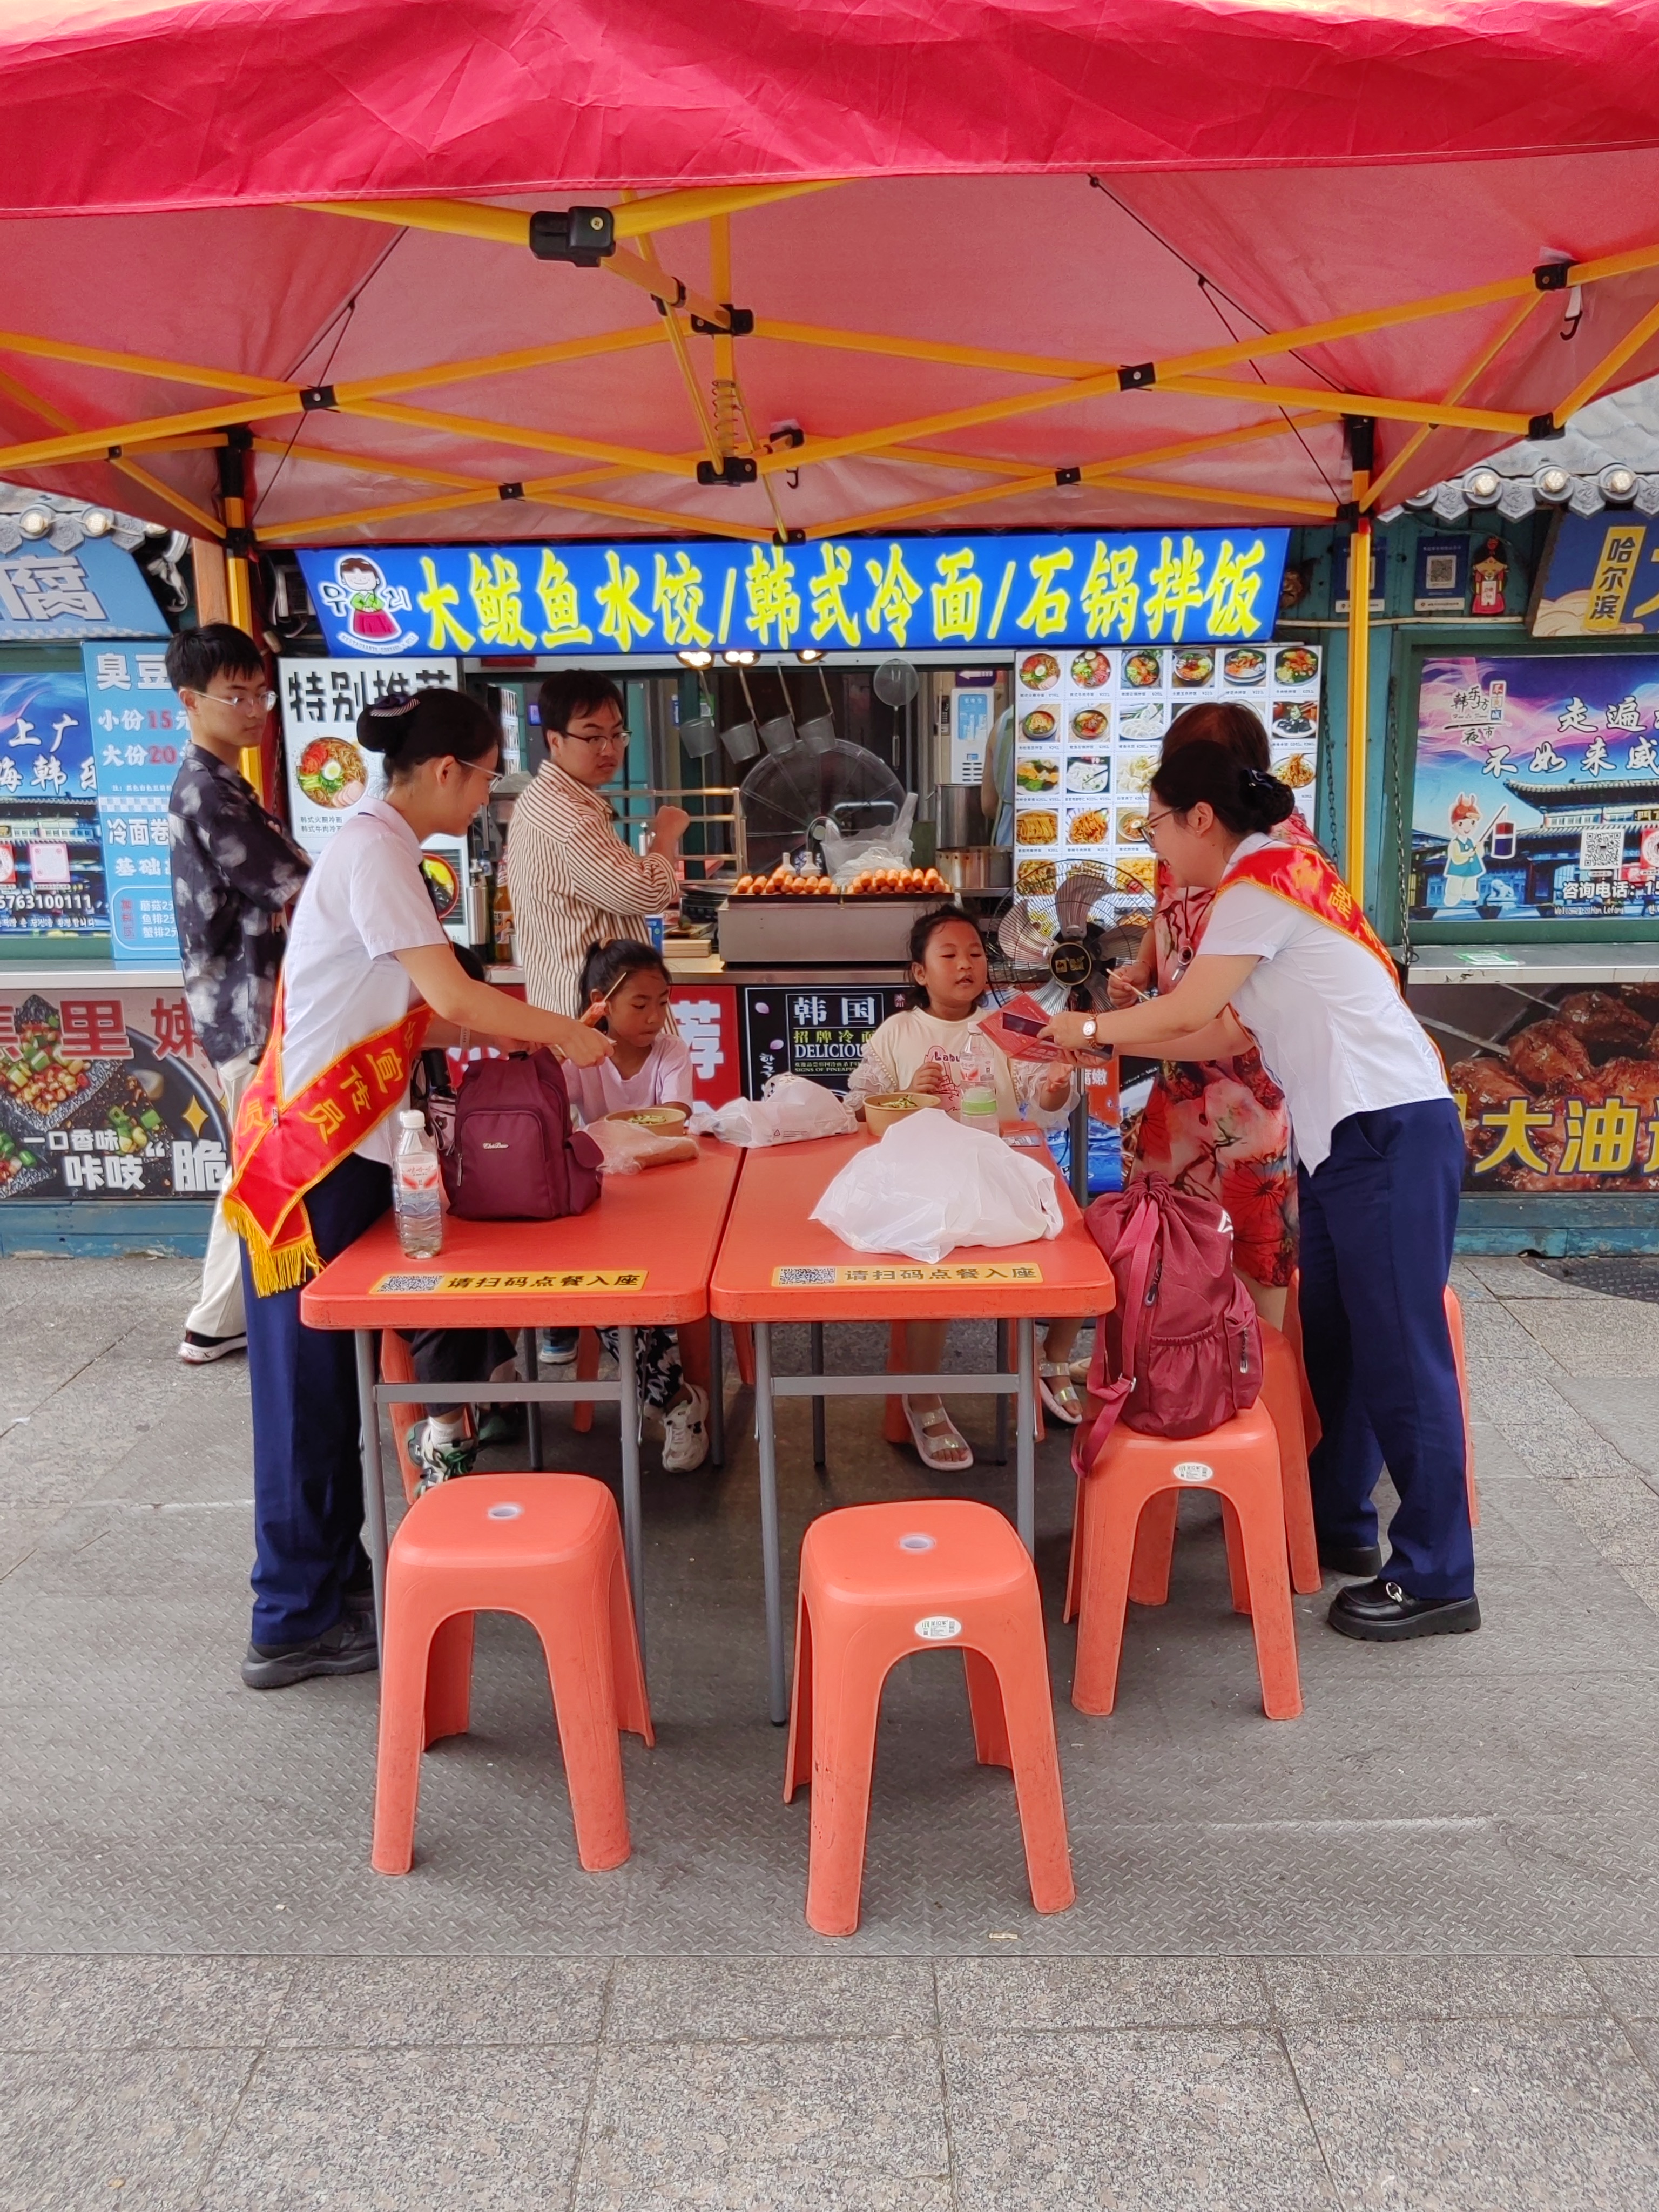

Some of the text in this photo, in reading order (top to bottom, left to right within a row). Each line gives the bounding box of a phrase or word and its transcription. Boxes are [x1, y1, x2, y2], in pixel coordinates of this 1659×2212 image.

[1589, 537, 1636, 621] 哈尔滨
[97, 652, 172, 691] 臭豆
[288, 669, 453, 723] 特别推
[1558, 696, 1659, 733] 走遍
[115, 857, 171, 876] 基础
[793, 996, 876, 1026] 韩国
[23, 1128, 119, 1152] 一口香味
[448, 1274, 641, 1289] 请扫码点餐入座
[844, 1267, 1038, 1282] 请扫码点餐入座
